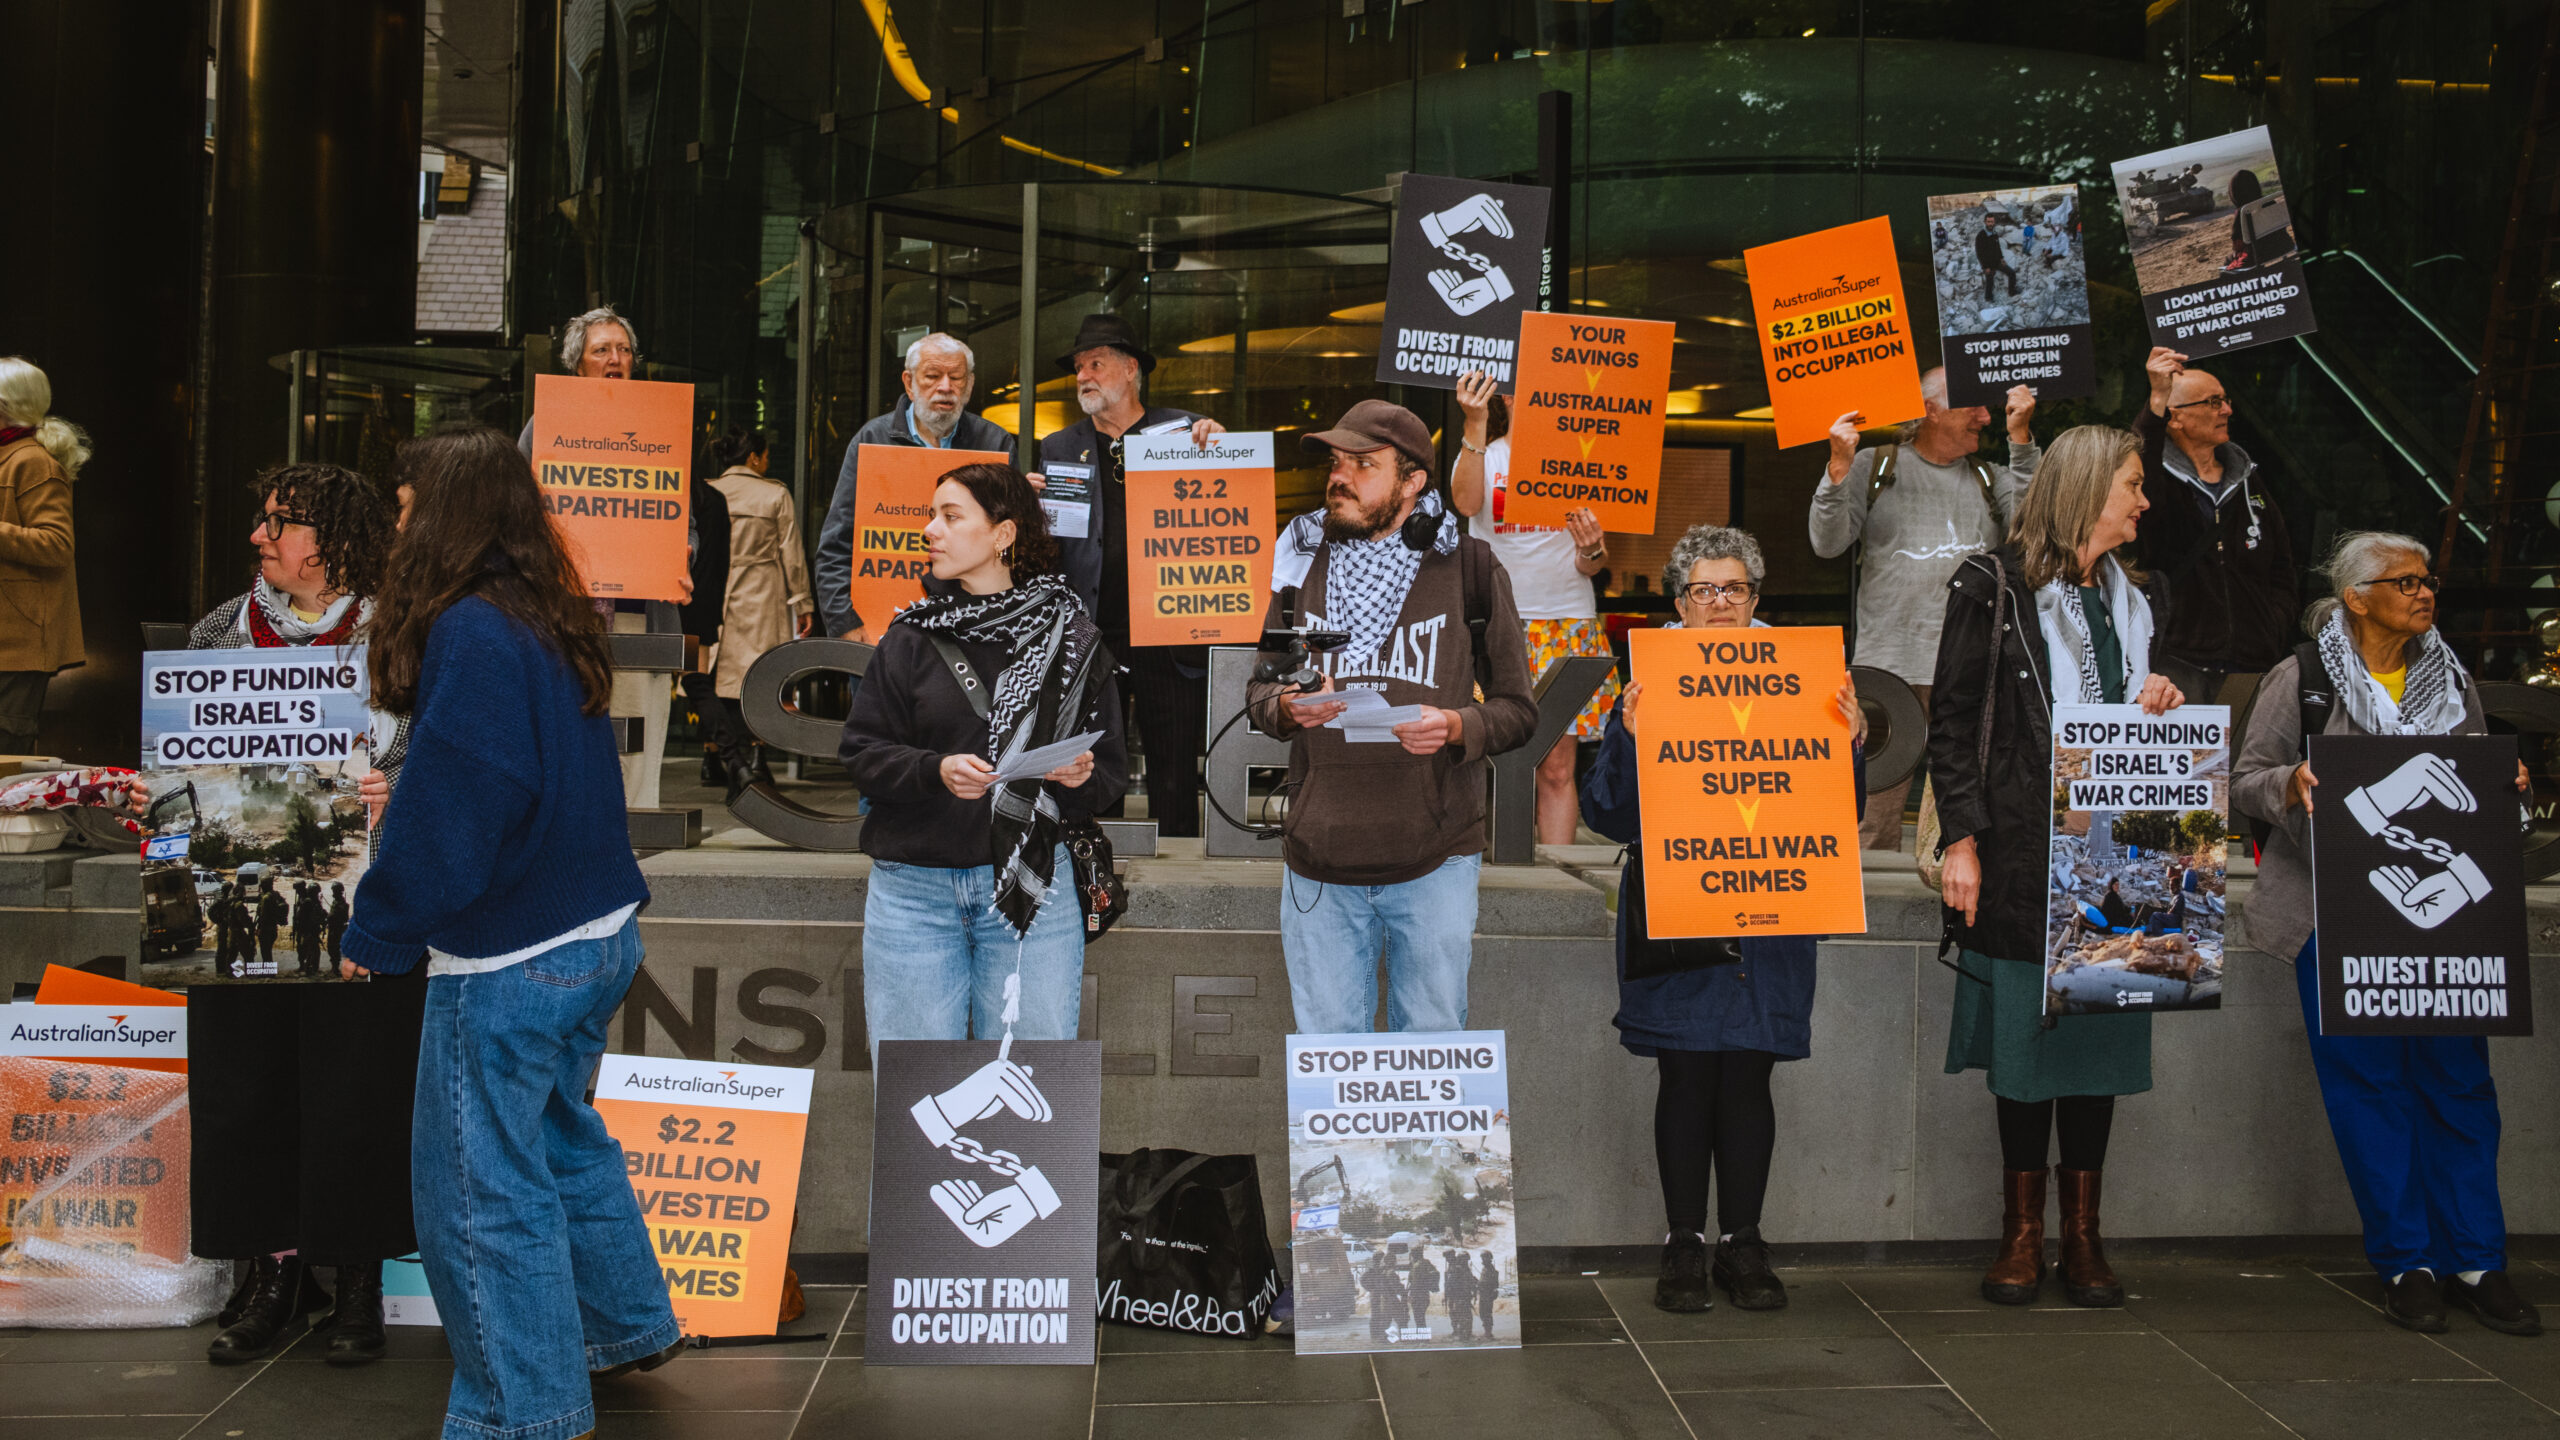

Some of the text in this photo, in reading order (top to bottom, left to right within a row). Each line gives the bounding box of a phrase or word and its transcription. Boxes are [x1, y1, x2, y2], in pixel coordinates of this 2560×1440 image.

[1540, 247, 1552, 296] Street
[1773, 275, 1881, 310] AustralianSuper
[2164, 298, 2171, 311] I
[2217, 277, 2260, 298] WANT
[2261, 272, 2283, 289] MY
[2156, 284, 2299, 328] RETIREMENT FUNDED
[1772, 298, 1893, 341] $2.2 BILLION
[2176, 303, 2286, 339] BY WAR CRIMES
[1397, 328, 1514, 361] DIVEST FROM
[1569, 325, 1626, 345] YOUR
[1773, 320, 1900, 362] INTO ILLEGAL
[1964, 333, 2070, 355] STOP INVESTING
[1395, 351, 1512, 383] OCCUPATION
[1551, 347, 1639, 369] SAVINGS
[1776, 340, 1904, 383] OCCUPATION
[1979, 350, 2060, 368] MY SUPER IN
[1978, 365, 2061, 384] WAR CRIMES
[1529, 391, 1652, 415] AUSTRALIAN
[1557, 416, 1620, 436] SUPER
[553, 434, 672, 456] AustralianSuper
[1144, 446, 1255, 462] AustralianSuper
[542, 464, 680, 491] INVESTS IN
[1174, 478, 1227, 501] $2.2
[1516, 480, 1648, 505] OCCUPATION
[543, 494, 681, 520] APARTHEID
[1154, 507, 1249, 529] BILLION
[1144, 536, 1260, 557] INVESTED
[1160, 565, 1246, 586] IN WAR
[1157, 593, 1251, 615] CRIMES
[1697, 642, 1778, 665] YOUR
[154, 665, 357, 695] STOP FUNDING
[1678, 673, 1801, 697] SAVINGS
[194, 699, 316, 727] ISRAEL'S
[162, 732, 347, 761] OCCUPATION
[2063, 721, 2221, 746] STOP FUNDING
[1657, 737, 1831, 763] AUSTRALIAN
[2094, 752, 2190, 776] ISRAEL'S
[1702, 771, 1792, 795] SUPER
[2074, 783, 2209, 807] WAR CRIMES
[1664, 835, 1839, 861] ISRAELI WAR
[1700, 869, 1807, 894] CRIMES
[2342, 956, 2507, 985] DIVEST FROM
[2344, 988, 2508, 1017] OCCUPATION
[10, 1023, 177, 1047] AustralianSuper
[1297, 1047, 1494, 1073] STOP FUNDING
[48, 1069, 128, 1102] $2.2
[624, 1072, 785, 1100] AustralianSuper
[1338, 1079, 1456, 1104] ISRAEL'S
[657, 1114, 737, 1146] $2.2
[1308, 1109, 1488, 1135] OCCUPATION
[623, 1150, 761, 1185] BILLION
[6, 1199, 137, 1228] IN WAR
[658, 1229, 742, 1259] WAR
[892, 1277, 1069, 1309] DIVEST FROM
[891, 1312, 1068, 1344] OCCUPATION
